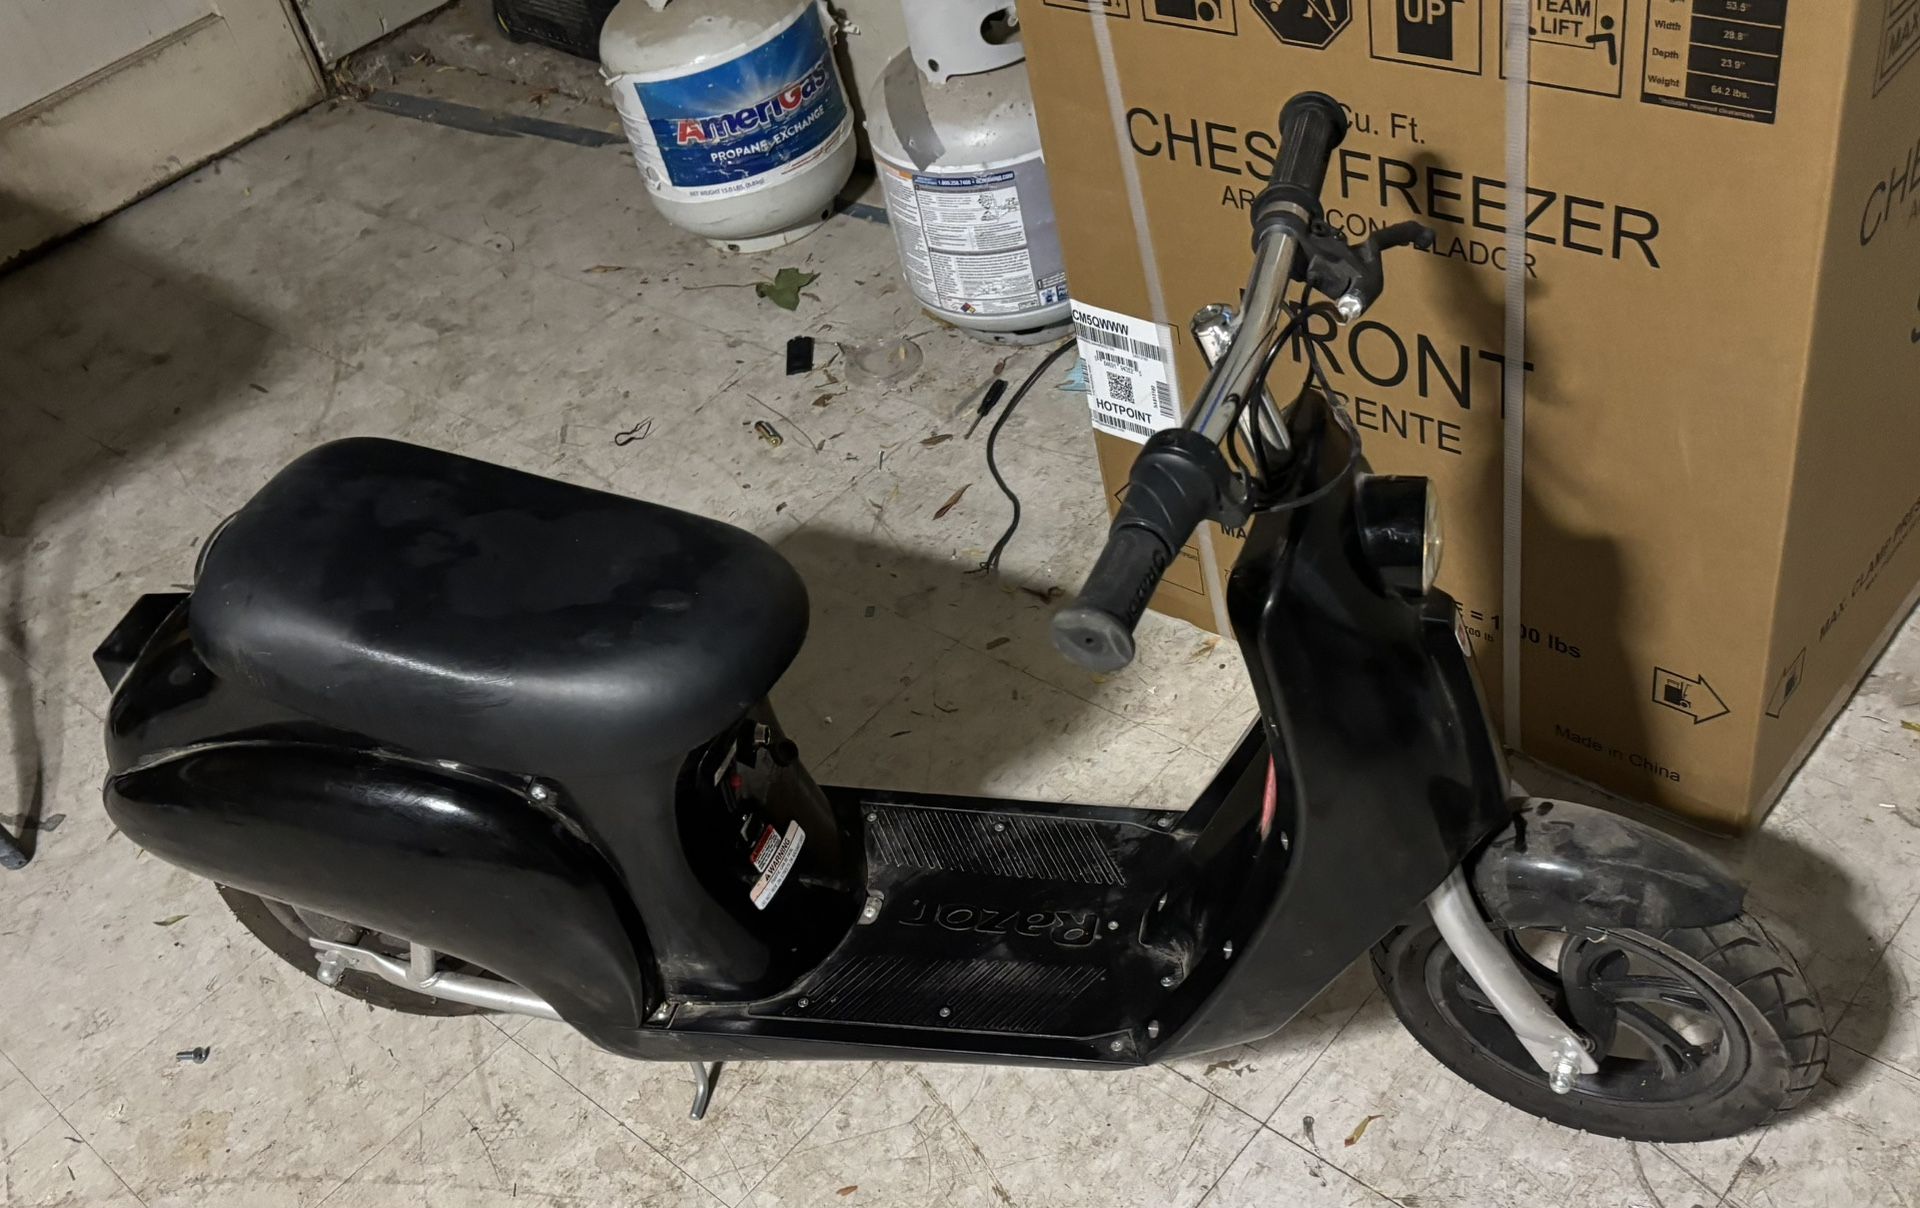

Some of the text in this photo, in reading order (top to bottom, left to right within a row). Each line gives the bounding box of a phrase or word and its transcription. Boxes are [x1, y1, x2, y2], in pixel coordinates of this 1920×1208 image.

[1404, 0, 1446, 24] UP
[1541, 16, 1583, 37] LIFT
[1654, 20, 1682, 31] Width
[1652, 47, 1680, 60] Depth
[1648, 74, 1680, 88] Weight
[677, 61, 829, 145] AmeriGas
[711, 105, 825, 163] PROPANE EXCHANGE
[1391, 112, 1425, 144] Ft.
[1126, 107, 1661, 269] CHES FREEZER
[1072, 309, 1129, 336] CM5QWWW
[1279, 299, 1534, 420] RONT
[1096, 398, 1152, 424] HOTPOINT
[1304, 383, 1462, 455] ENTE
[1548, 634, 1581, 658] lbs
[1555, 724, 1680, 782] Made in China
[768, 837, 791, 874] WARNING
[899, 899, 1101, 947] Razor
